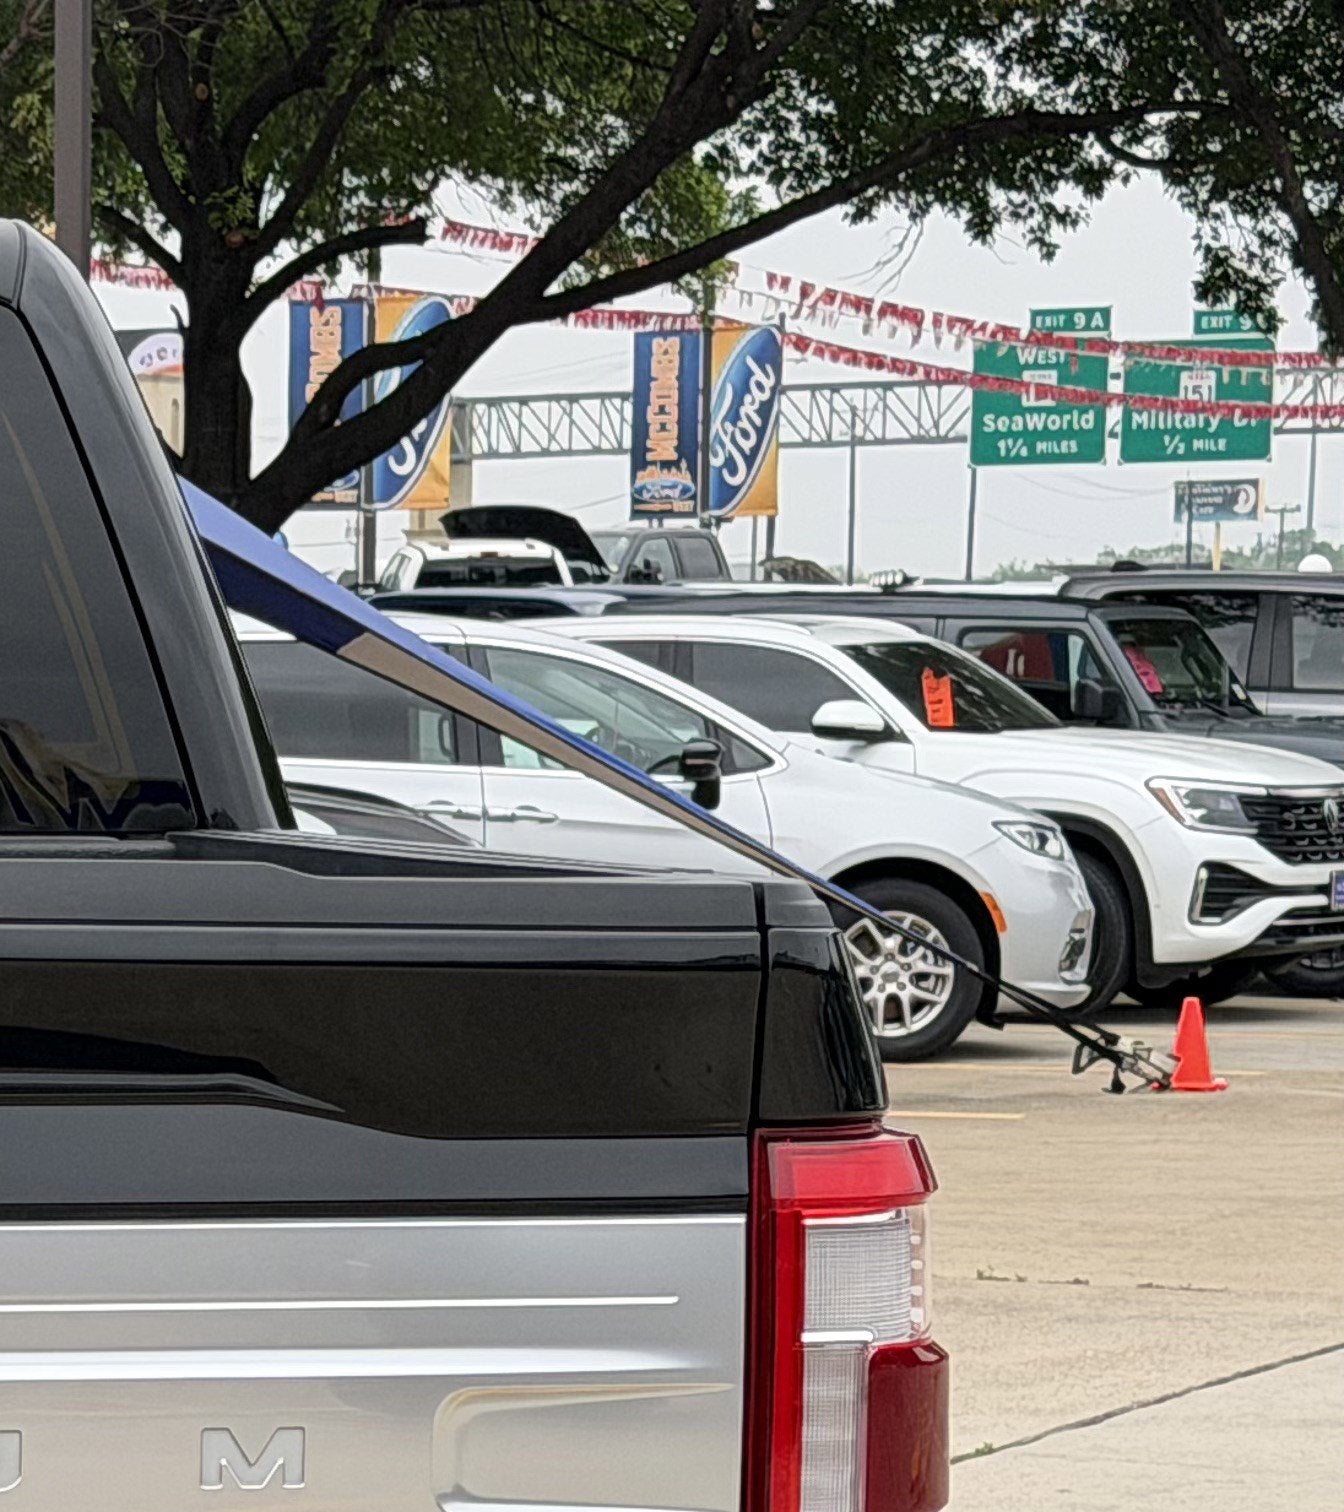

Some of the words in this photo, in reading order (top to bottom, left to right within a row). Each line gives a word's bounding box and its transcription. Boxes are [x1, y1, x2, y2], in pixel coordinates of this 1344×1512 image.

[1035, 314, 1066, 328] EXIT
[1201, 315, 1234, 330] EXIT
[1016, 346, 1066, 366] WEST
[710, 354, 776, 487] Ford
[982, 409, 1095, 433] SeaWorld
[1131, 408, 1221, 433] Military
[1035, 440, 1078, 455] MILES
[1192, 438, 1228, 452] MILE
